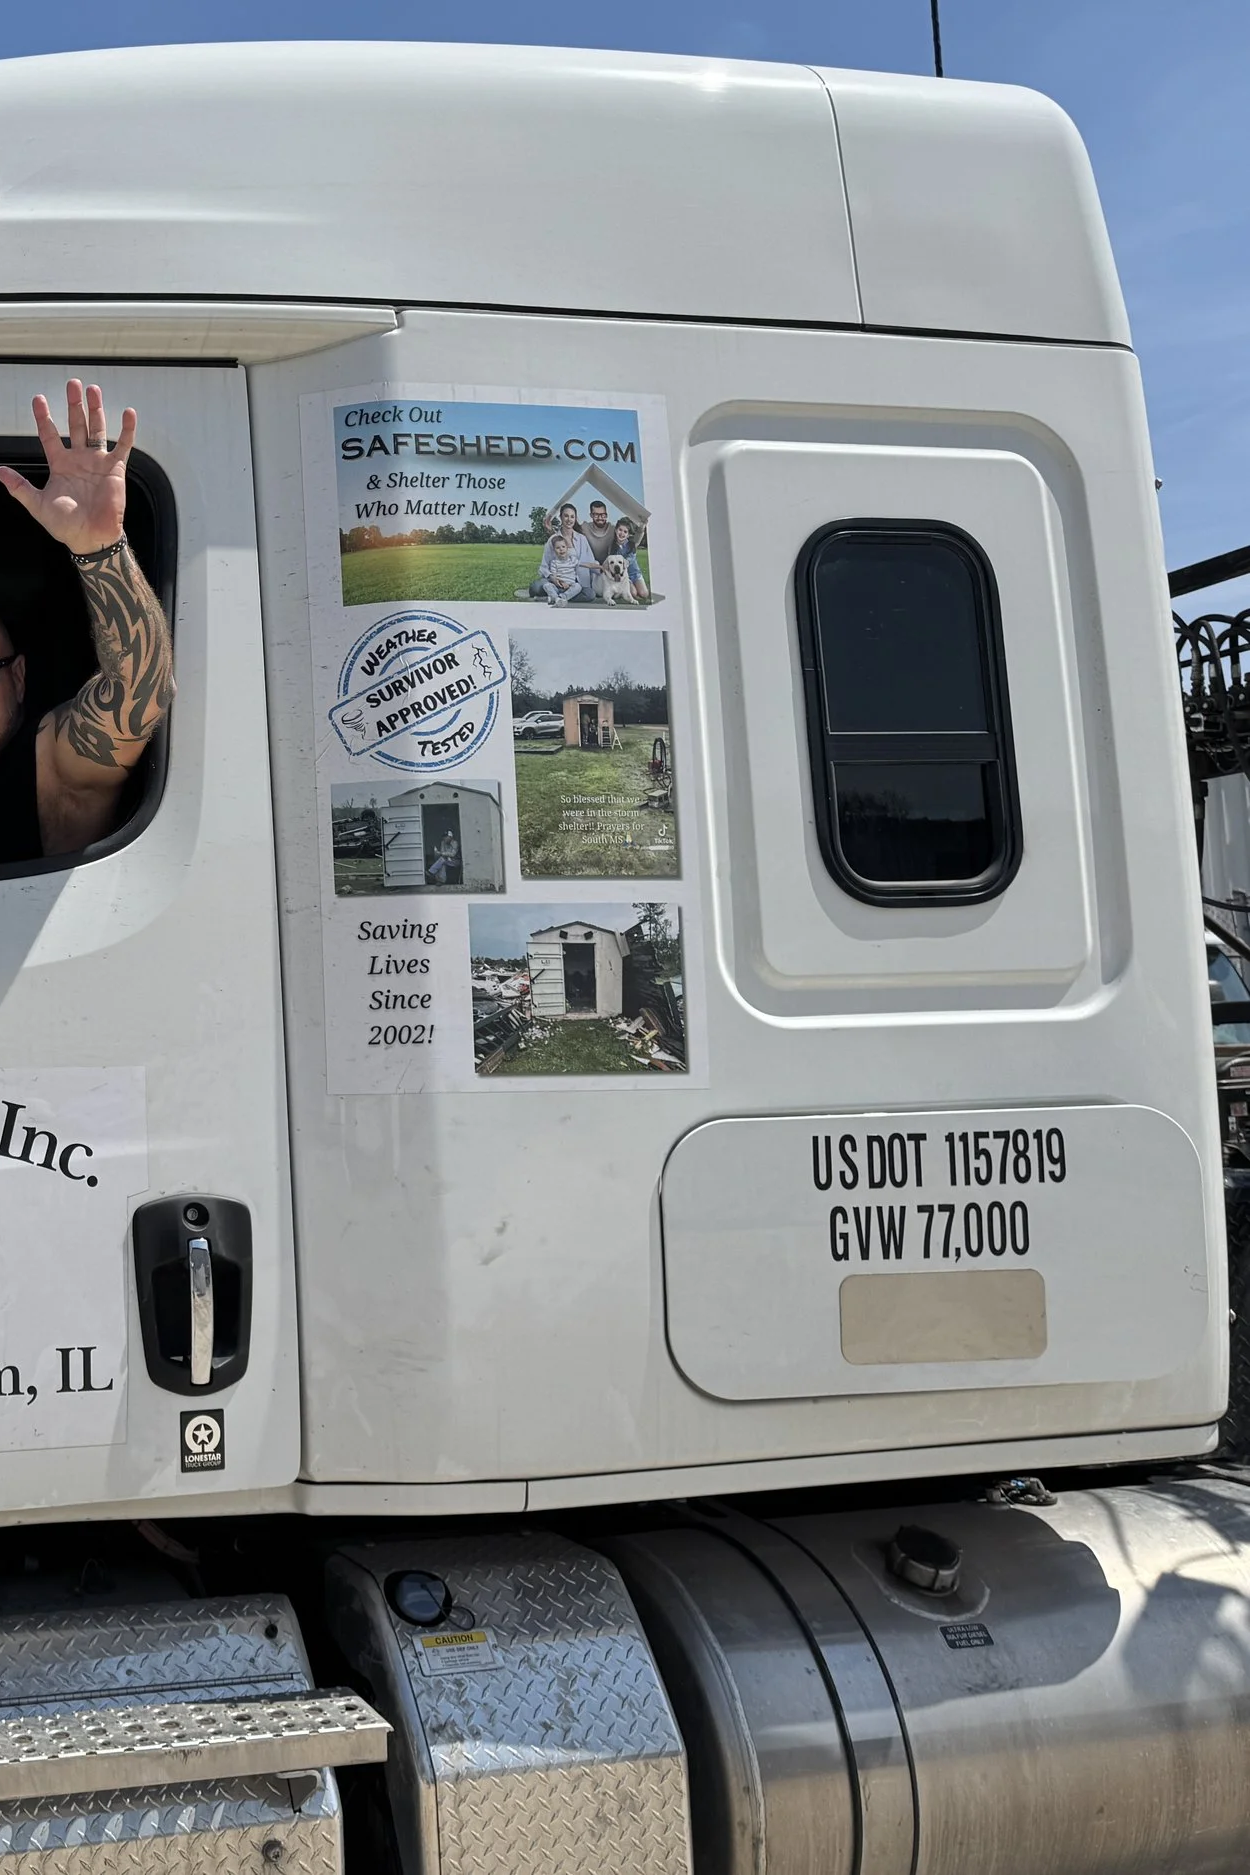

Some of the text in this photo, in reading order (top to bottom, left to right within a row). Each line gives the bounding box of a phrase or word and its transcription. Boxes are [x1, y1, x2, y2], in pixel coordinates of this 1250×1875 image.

[345, 406, 443, 427] Check Out
[341, 433, 637, 463] SAFESHEDS.COM
[366, 472, 506, 490] & Shelter Those
[355, 500, 519, 519] Who Matter Most!
[360, 629, 437, 676] WEATHER
[366, 652, 460, 708] SURVIVOR
[376, 674, 477, 737] APPROVED!
[418, 721, 475, 756] TESTED
[560, 795, 640, 804] So blessed that we
[562, 808, 639, 817] were in the storm
[597, 822, 630, 834] Prayers
[632, 821, 645, 831] for
[582, 834, 623, 844] South MS
[357, 919, 439, 945] Saving
[367, 955, 431, 976] Lives
[368, 990, 432, 1010] Since
[367, 1023, 436, 1046] 2002!
[944, 1127, 1067, 1187] 1157819
[830, 1200, 1030, 1263] GVW 77,000
[55, 1346, 114, 1394] IL
[185, 1453, 221, 1463] LONESTAR
[435, 1634, 473, 1645] CAUTION
